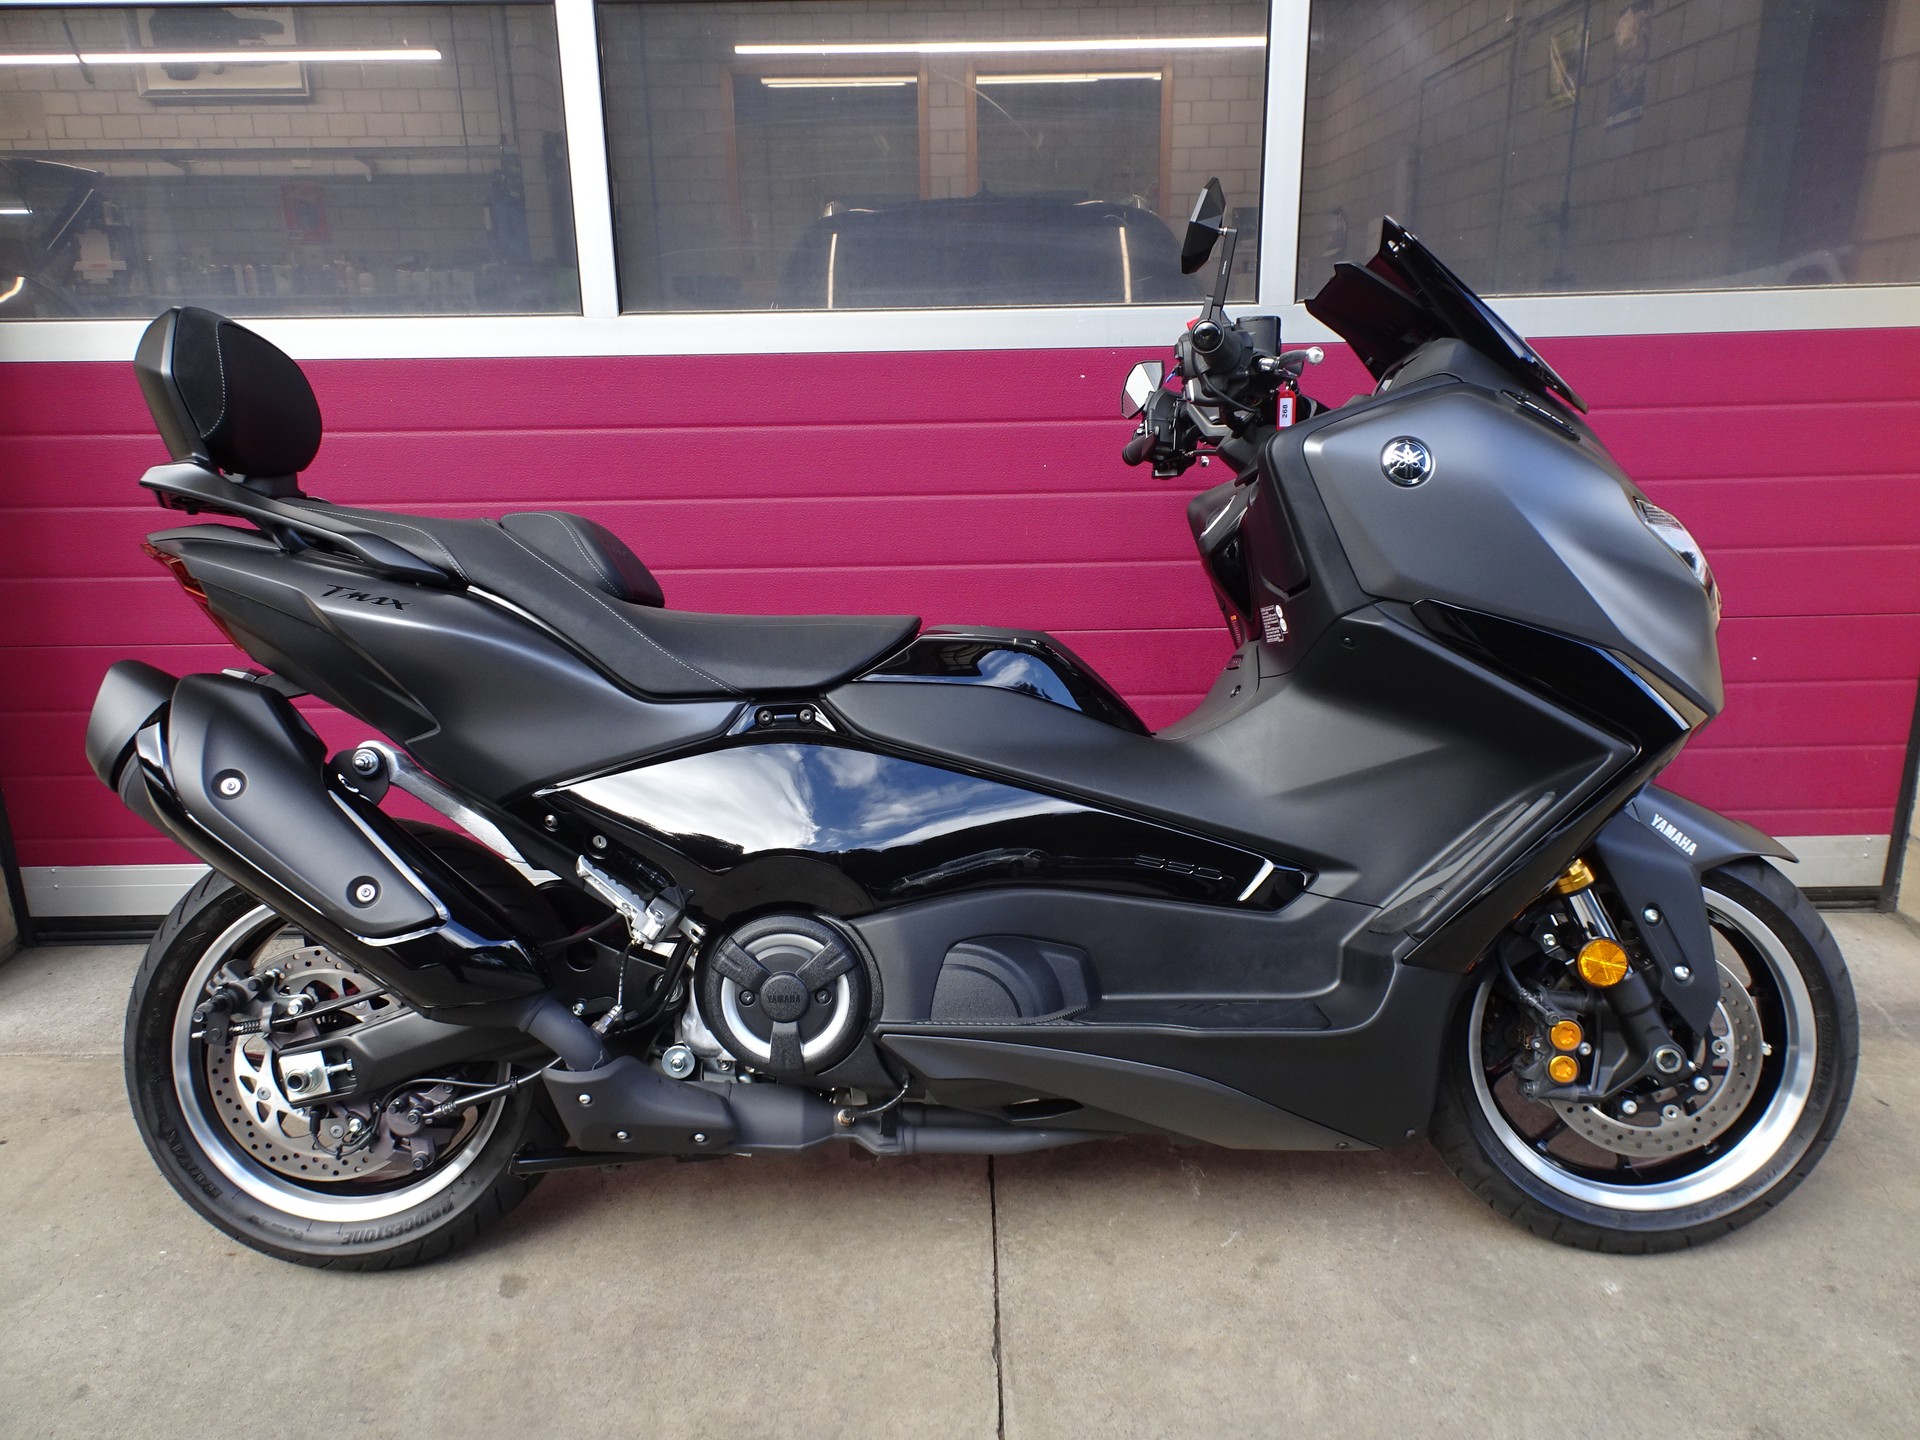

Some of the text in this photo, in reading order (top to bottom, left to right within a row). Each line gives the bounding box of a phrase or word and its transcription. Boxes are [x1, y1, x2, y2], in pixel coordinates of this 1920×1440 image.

[321, 584, 411, 611] TMAX
[1651, 813, 1697, 856] YAMAHA
[767, 994, 802, 1003] YAMAHA
